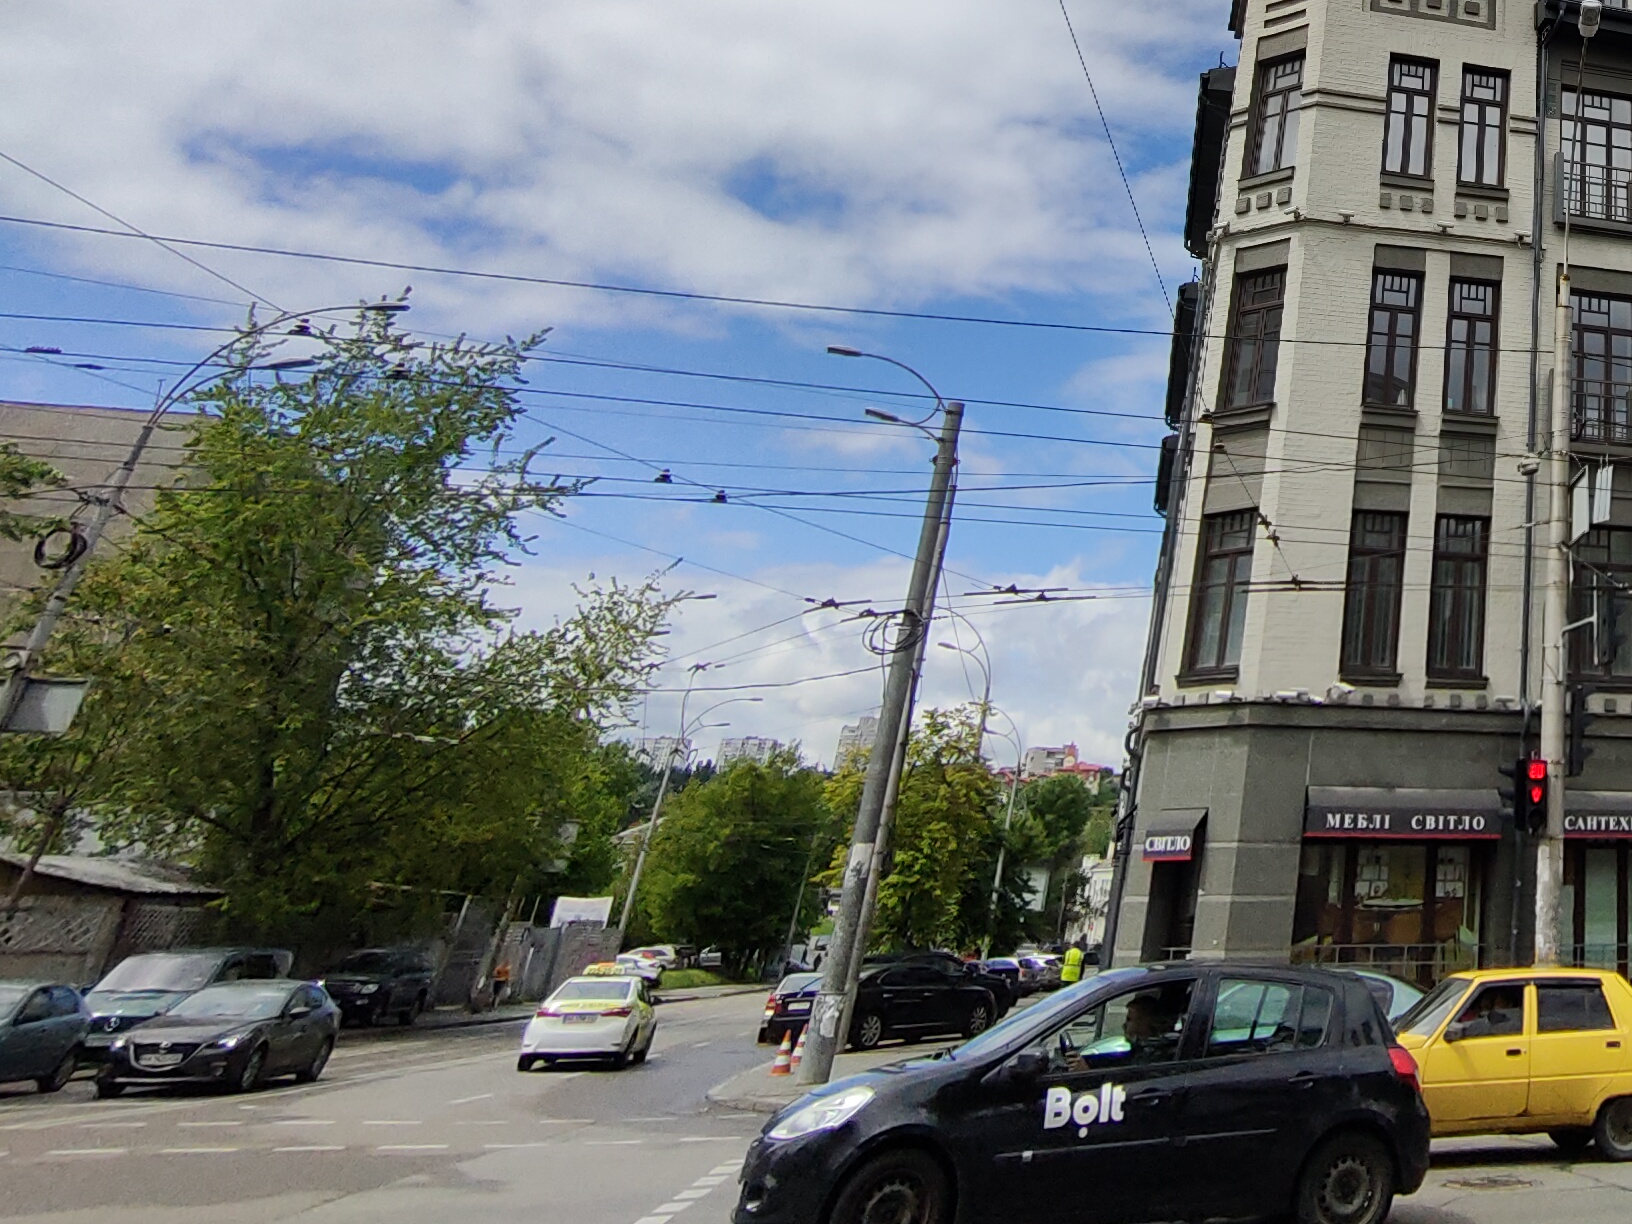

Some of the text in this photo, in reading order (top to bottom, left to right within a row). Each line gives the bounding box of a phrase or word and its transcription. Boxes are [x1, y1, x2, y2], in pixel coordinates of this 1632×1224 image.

[1325, 813, 1486, 831] МЕБЛІ СВІТЛО
[1145, 836, 1191, 852] СВІТЛО
[1043, 1082, 1126, 1138] Bolt
